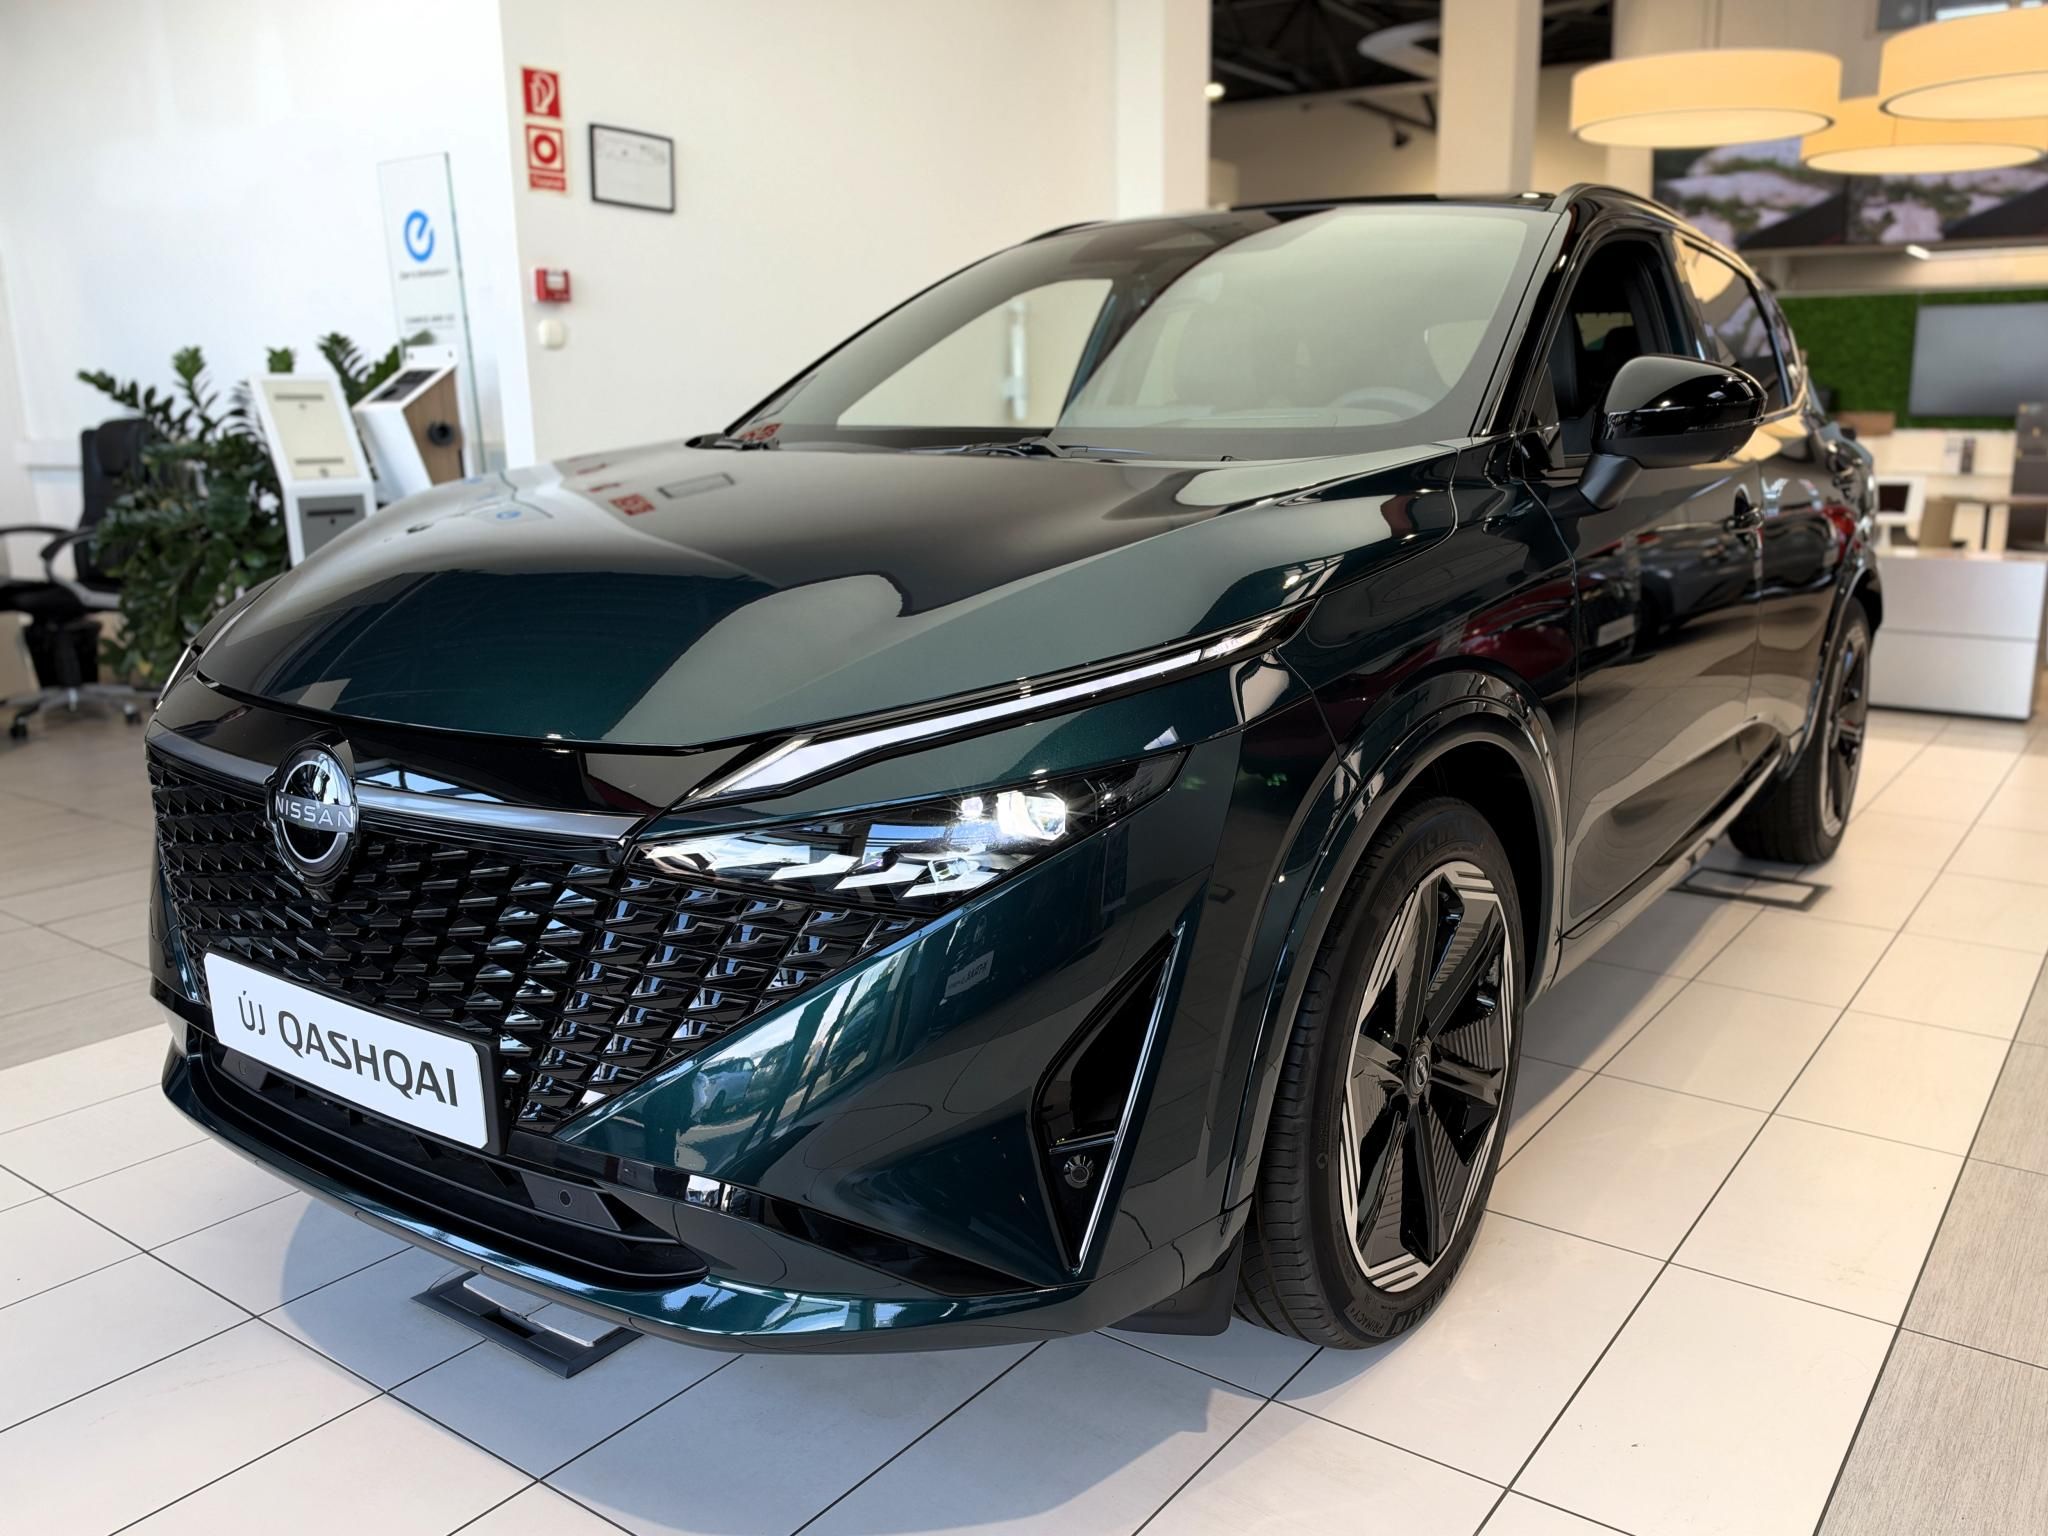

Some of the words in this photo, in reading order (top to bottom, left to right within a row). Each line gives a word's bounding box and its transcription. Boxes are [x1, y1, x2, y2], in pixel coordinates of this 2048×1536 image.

[275, 795, 354, 828] NISSAN
[238, 990, 266, 1036] ÚJ
[278, 1010, 458, 1107] QASHQAI
[1352, 1310, 1384, 1334] PRIMACY
